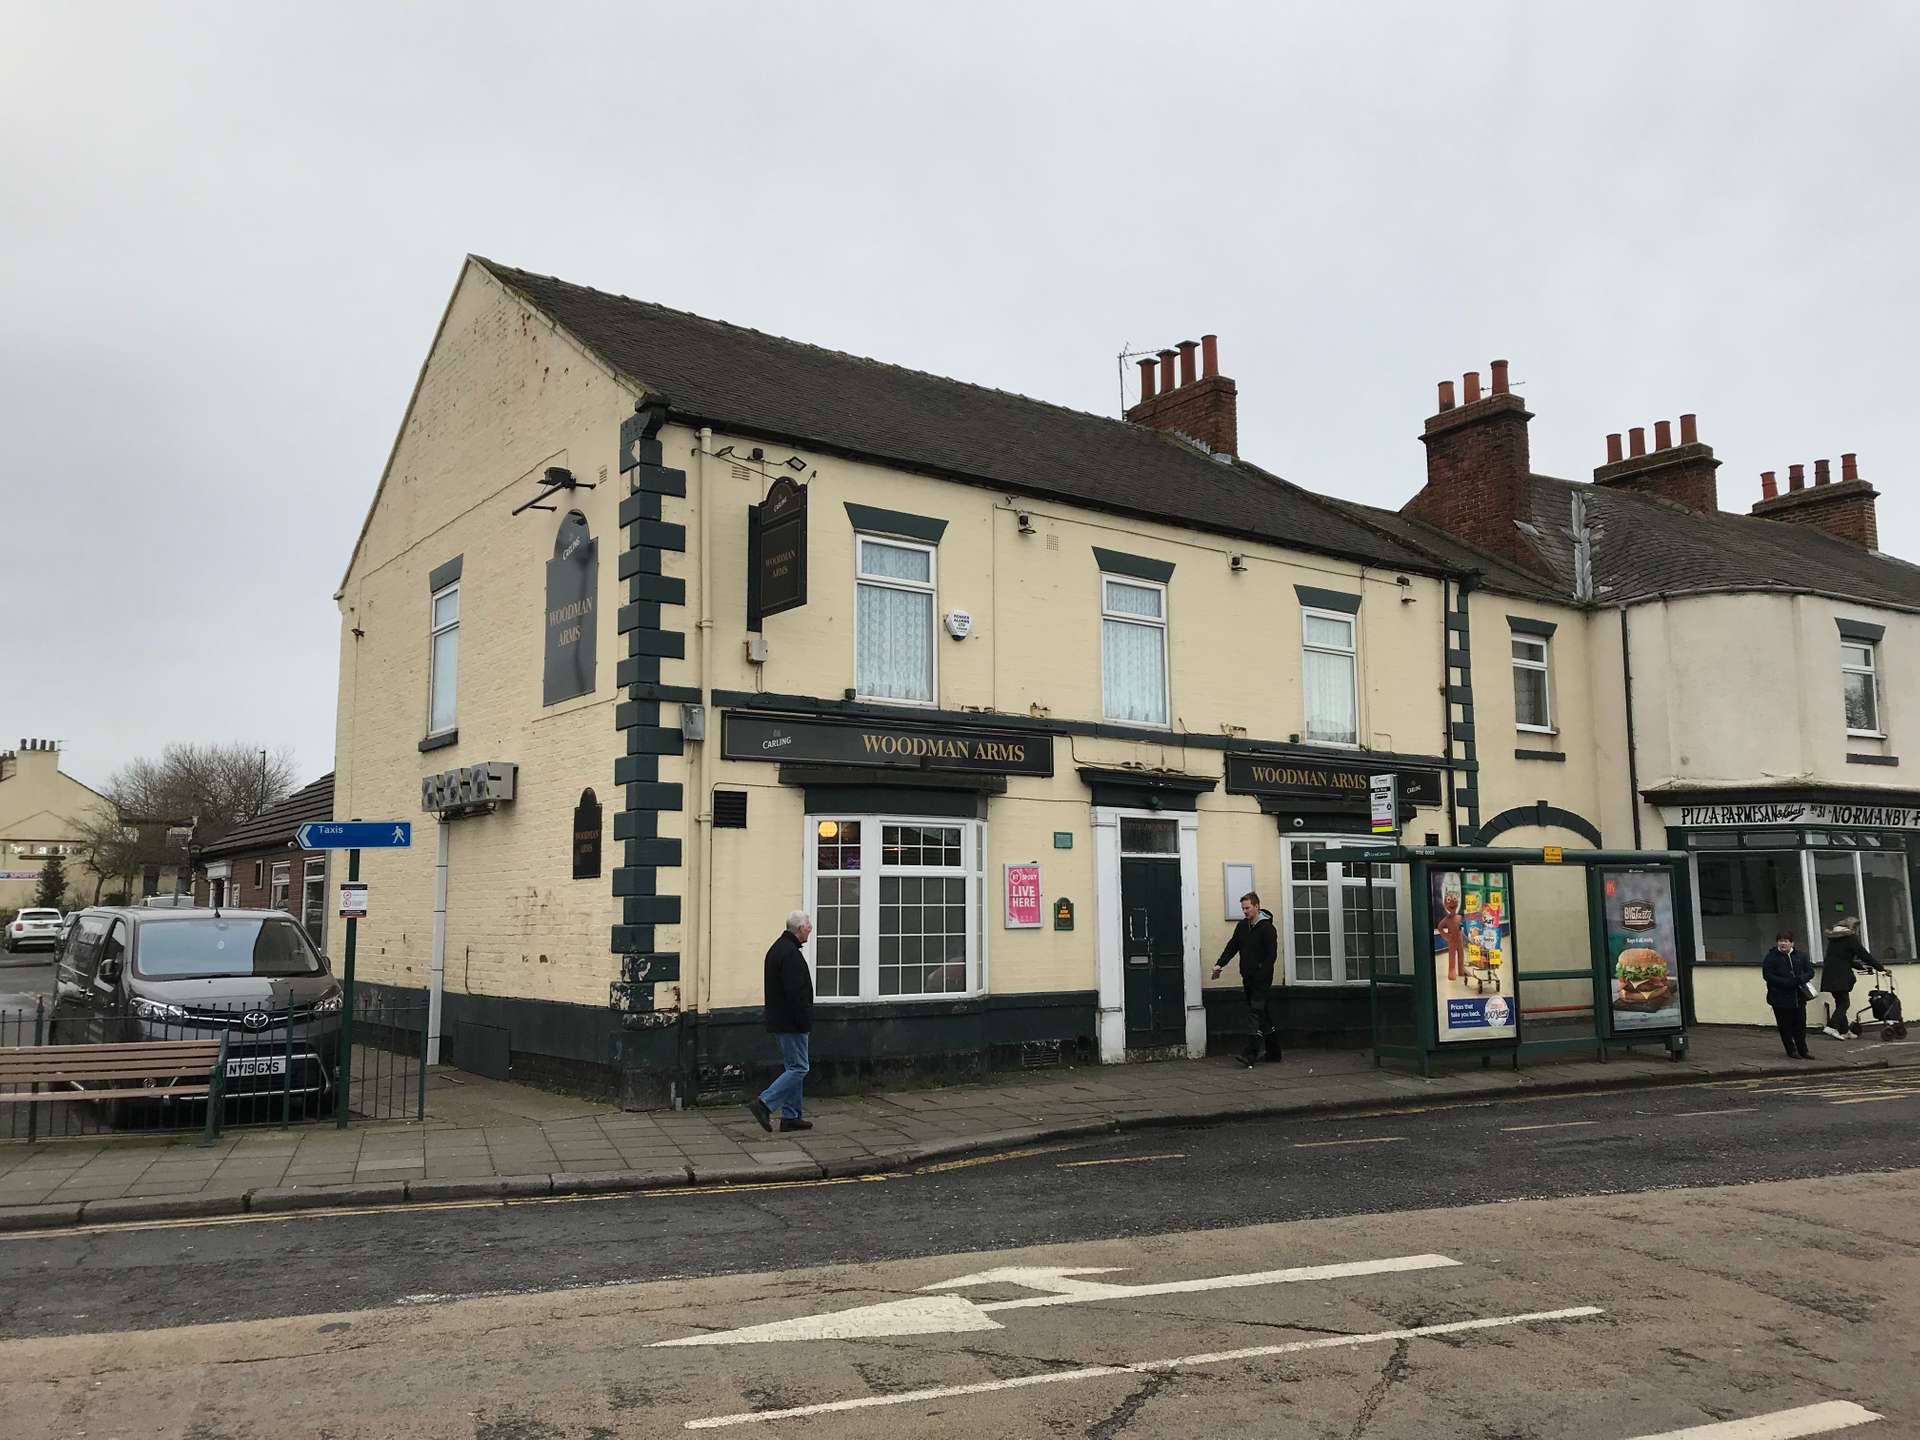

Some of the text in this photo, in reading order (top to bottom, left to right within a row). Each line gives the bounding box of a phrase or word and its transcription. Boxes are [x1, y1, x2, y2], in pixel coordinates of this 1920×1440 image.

[549, 597, 593, 626] WOODMAN
[558, 625, 581, 648] ARMS
[762, 736, 792, 750] CARLING
[862, 734, 1025, 762] WOODMAN ARMS
[1252, 766, 1328, 787] WOODMAN
[1330, 773, 1367, 790] ARMS
[1831, 806, 1911, 827] NORMANBY
[317, 825, 344, 834] Taxis
[1012, 885, 1036, 897] LIVE
[1012, 897, 1036, 908] HERE
[1624, 906, 1636, 920] BIG
[229, 1061, 280, 1075] NY19 GXS
